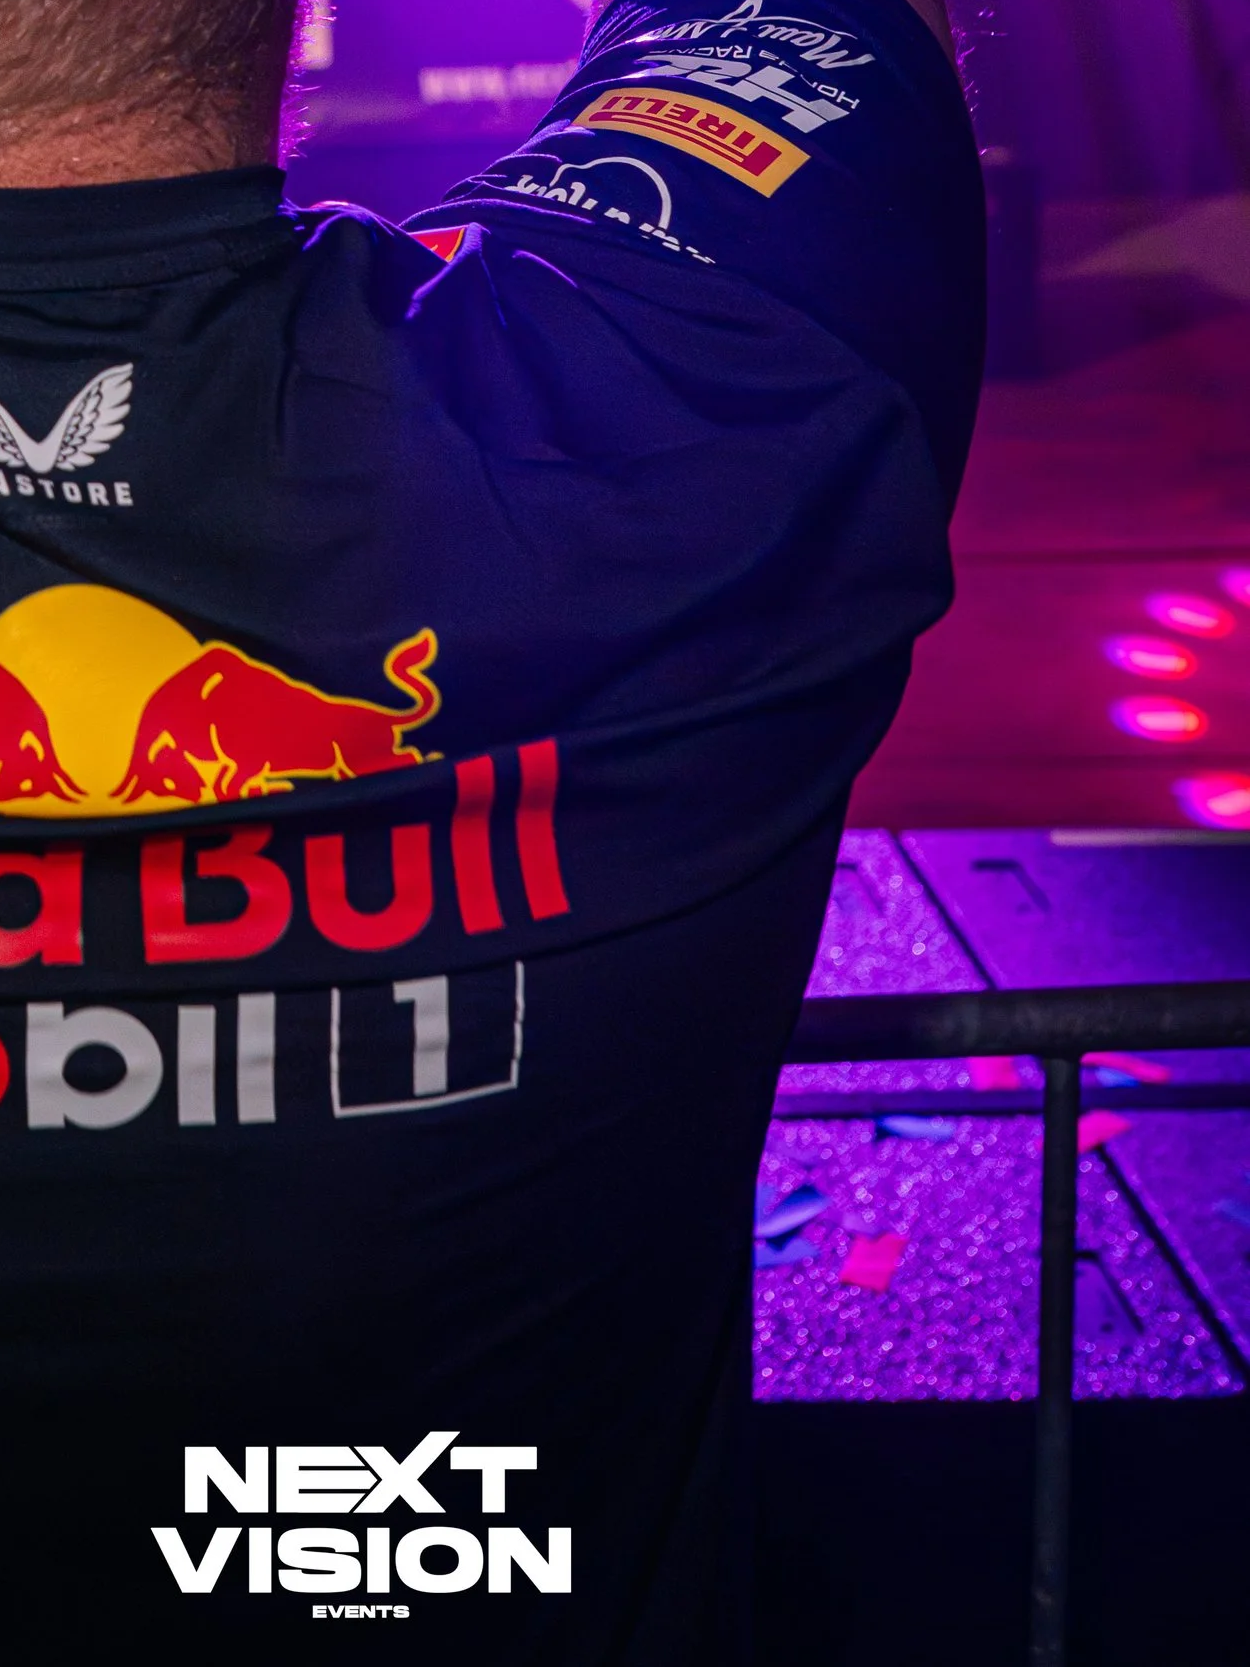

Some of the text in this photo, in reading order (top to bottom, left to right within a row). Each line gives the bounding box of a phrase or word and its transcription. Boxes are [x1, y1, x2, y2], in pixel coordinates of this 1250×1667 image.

[588, 95, 783, 178] PIRELLI
[139, 737, 571, 965] Bull
[392, 974, 450, 1097] 1
